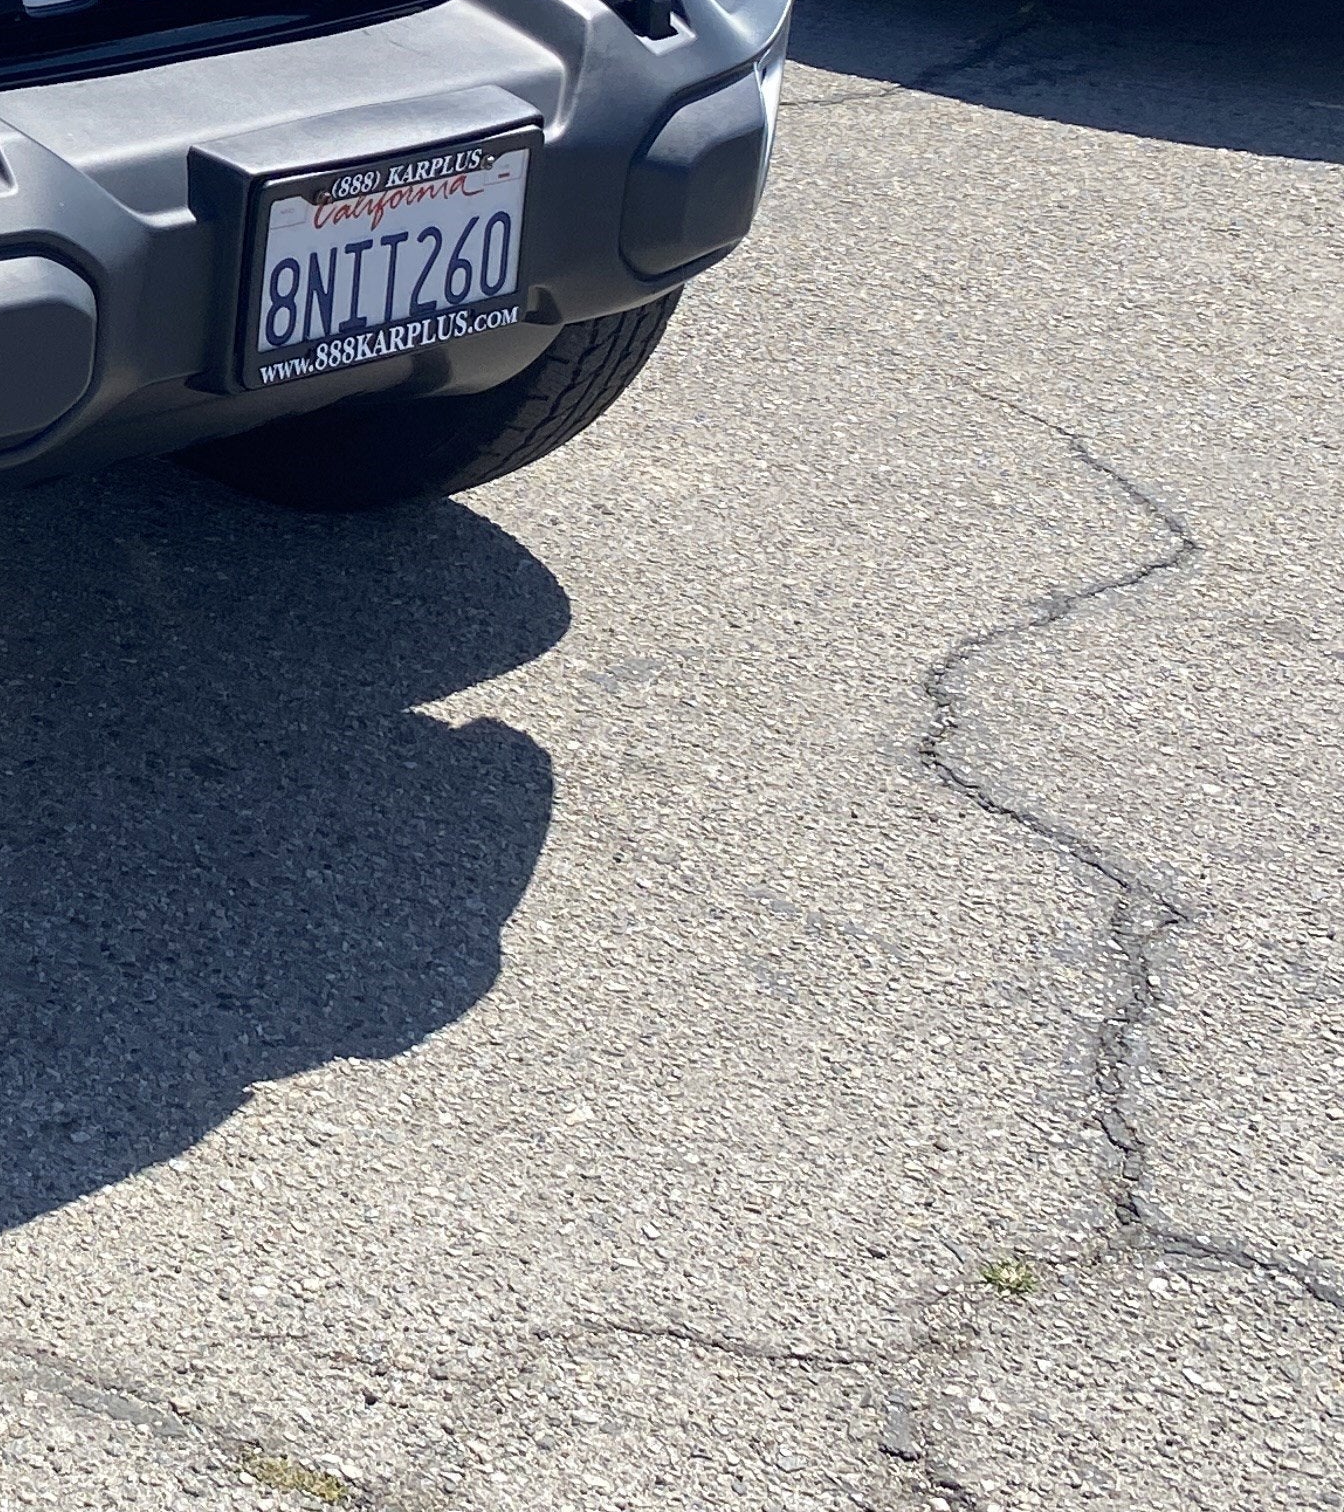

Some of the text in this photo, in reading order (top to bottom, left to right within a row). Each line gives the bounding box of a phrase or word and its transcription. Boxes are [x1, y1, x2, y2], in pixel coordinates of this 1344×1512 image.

[312, 174, 486, 232] California
[330, 148, 484, 200] (888) KARPLUS
[265, 210, 512, 347] 8NIT260
